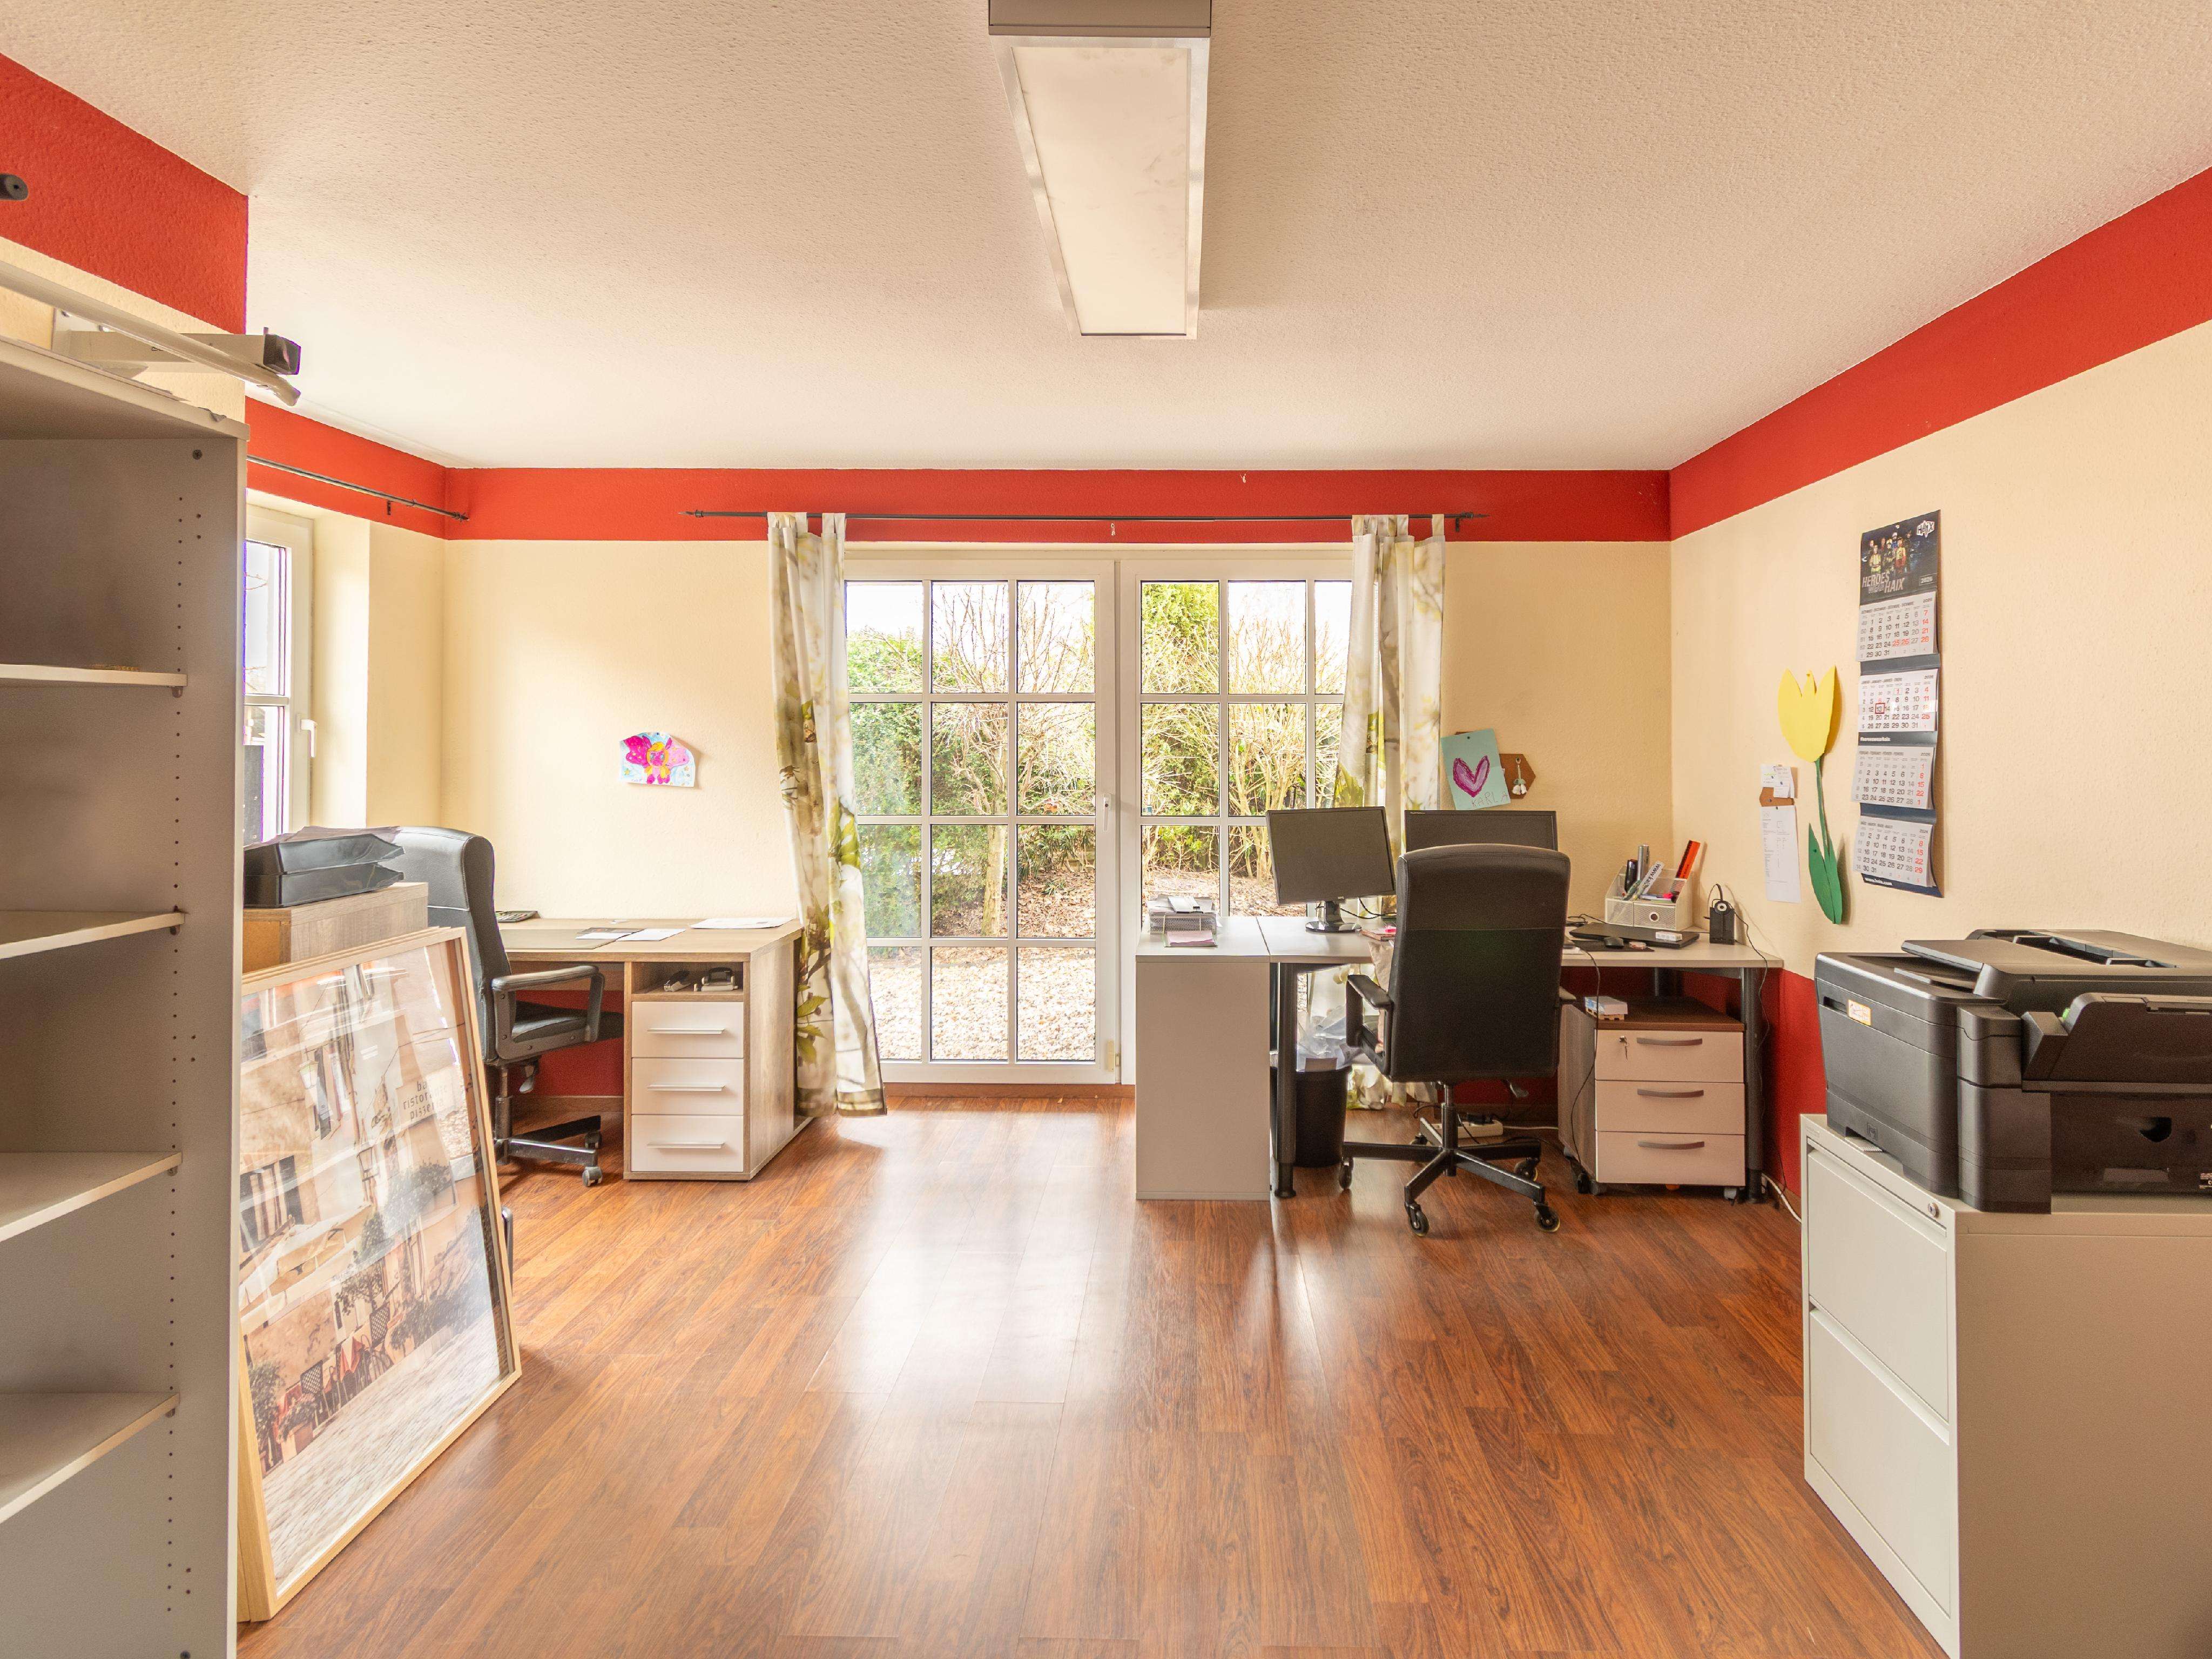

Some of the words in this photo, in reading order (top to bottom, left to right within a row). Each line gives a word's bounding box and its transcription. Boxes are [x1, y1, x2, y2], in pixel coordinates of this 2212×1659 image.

[1917, 521, 1935, 538] HAIX
[1862, 572, 1890, 588] HEROES
[1884, 578, 1905, 593] HAIX
